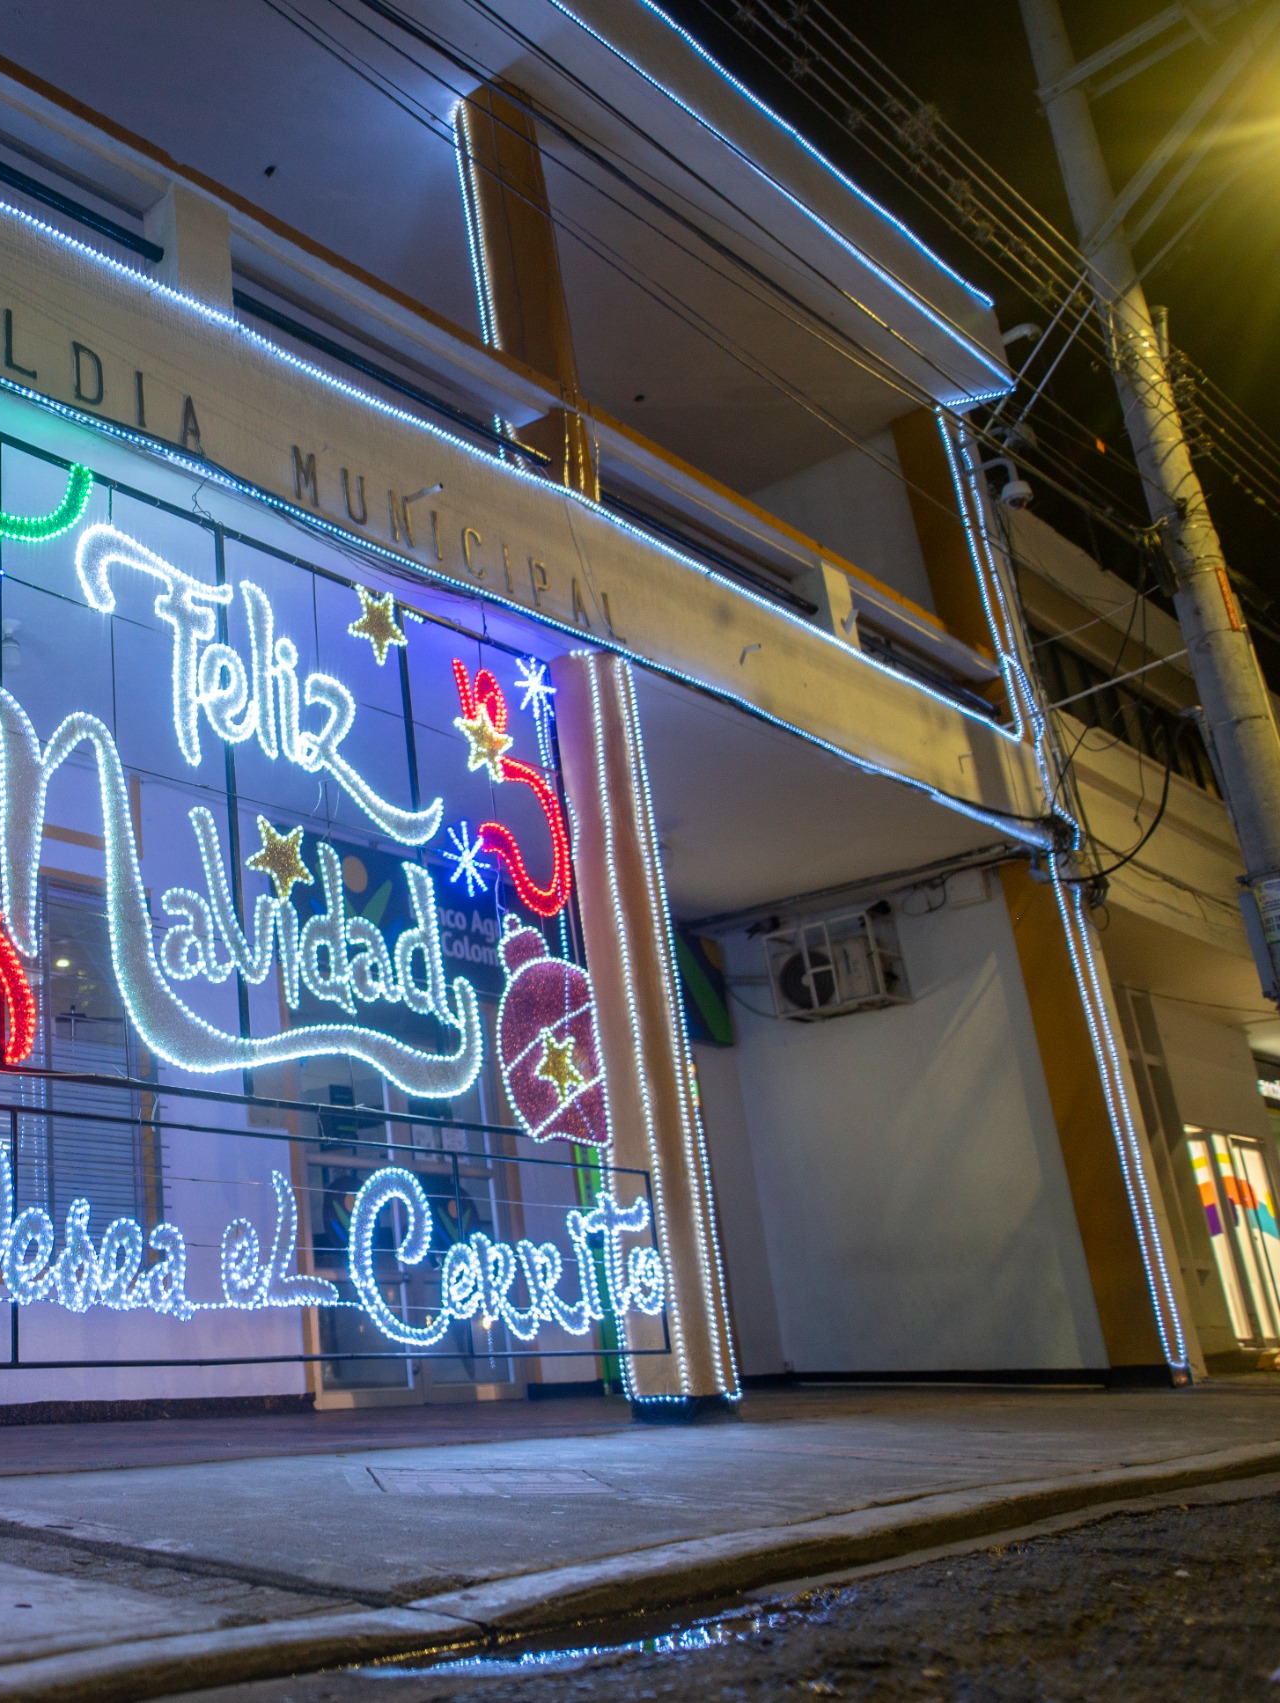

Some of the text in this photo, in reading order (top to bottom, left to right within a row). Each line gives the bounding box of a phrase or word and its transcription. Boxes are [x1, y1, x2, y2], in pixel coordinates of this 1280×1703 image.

[291, 445, 626, 644] MUNICIPAL
[74, 522, 444, 846] Feliz
[348, 1166, 666, 1347] Cerrito
